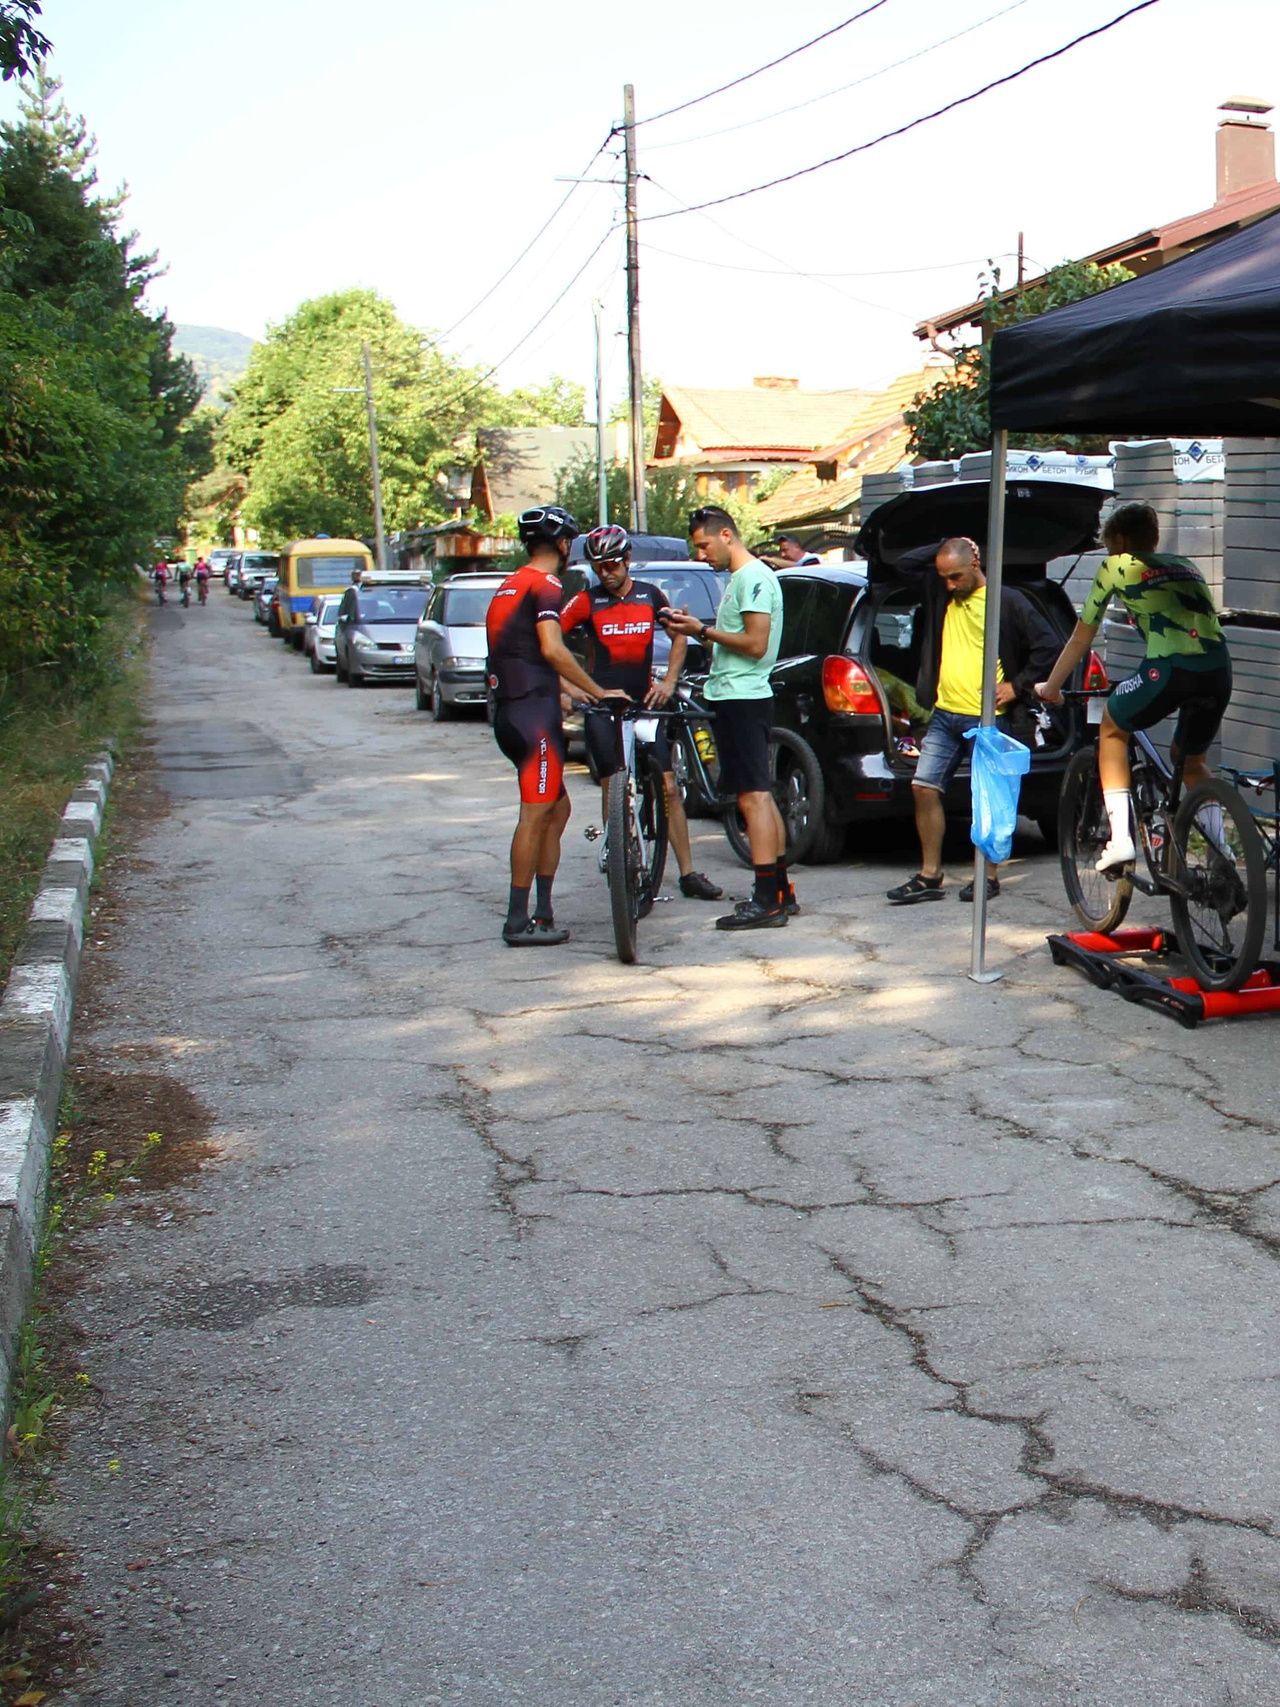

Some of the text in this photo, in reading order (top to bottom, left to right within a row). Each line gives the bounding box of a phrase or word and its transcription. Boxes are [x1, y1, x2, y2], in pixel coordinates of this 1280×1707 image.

[1075, 468, 1098, 476] РУБИК
[601, 621, 651, 636] OLIMP
[1115, 673, 1144, 696] VITOSHA
